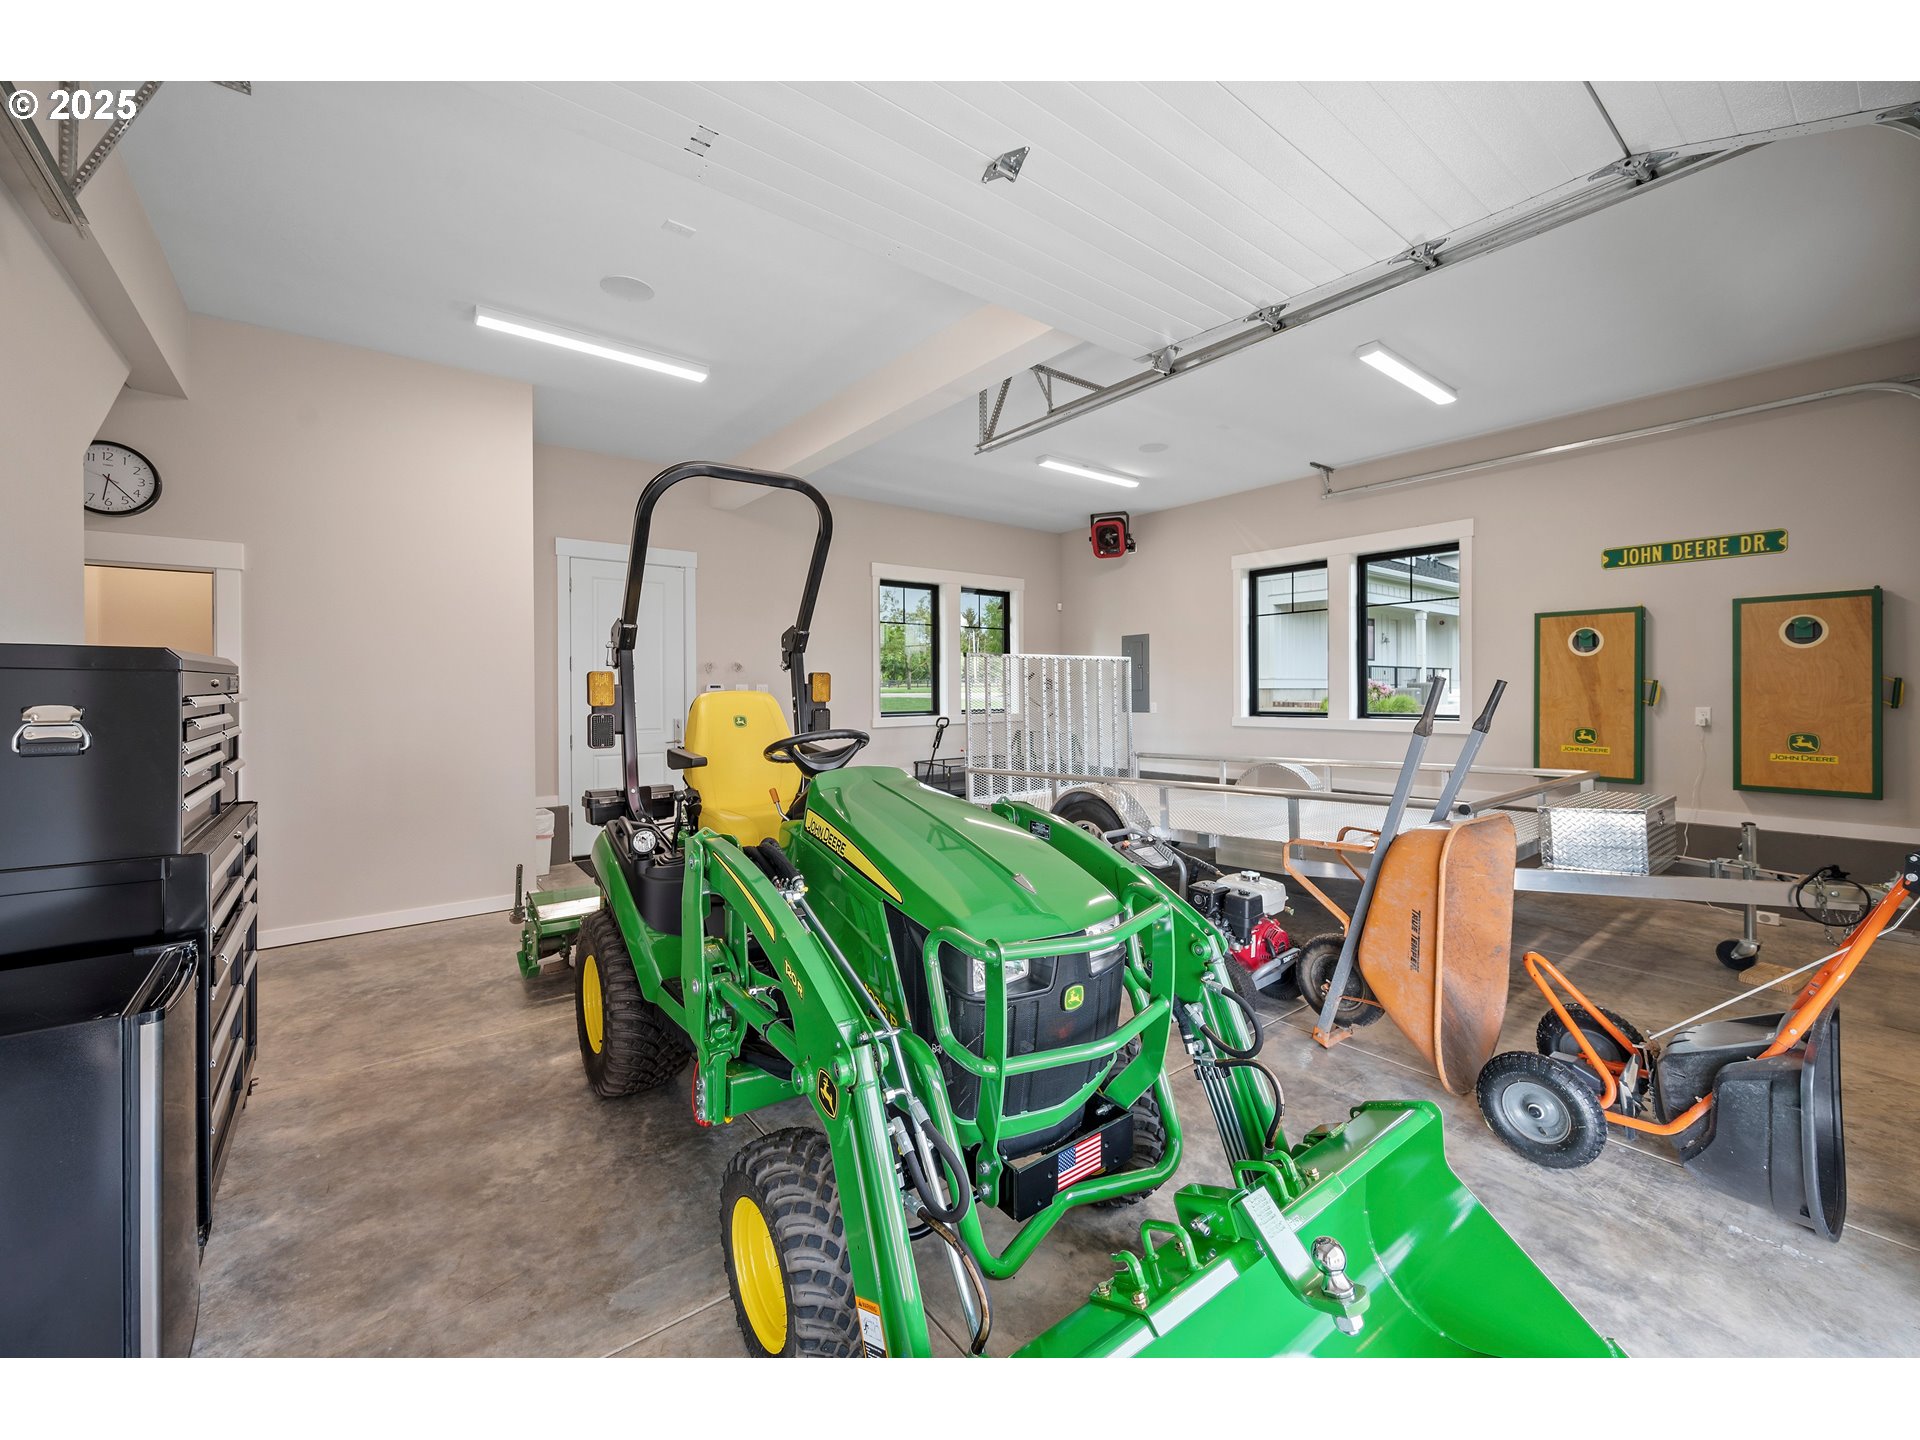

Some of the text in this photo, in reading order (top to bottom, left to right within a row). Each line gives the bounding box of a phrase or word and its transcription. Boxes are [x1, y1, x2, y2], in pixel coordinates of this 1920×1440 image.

[87, 452, 95, 462] 11
[102, 452, 114, 461] 12
[133, 466, 141, 475] 2
[138, 478, 146, 487] 3
[87, 492, 96, 502] 7
[133, 489, 141, 498] 4
[104, 497, 113, 507] 6
[121, 496, 129, 505] 5
[1618, 534, 1770, 566] JOHN DEERE DR.
[1772, 753, 1836, 763] JOHN DEERE
[807, 817, 847, 856] JOHN DEERE
[1411, 909, 1421, 933] TRUE
